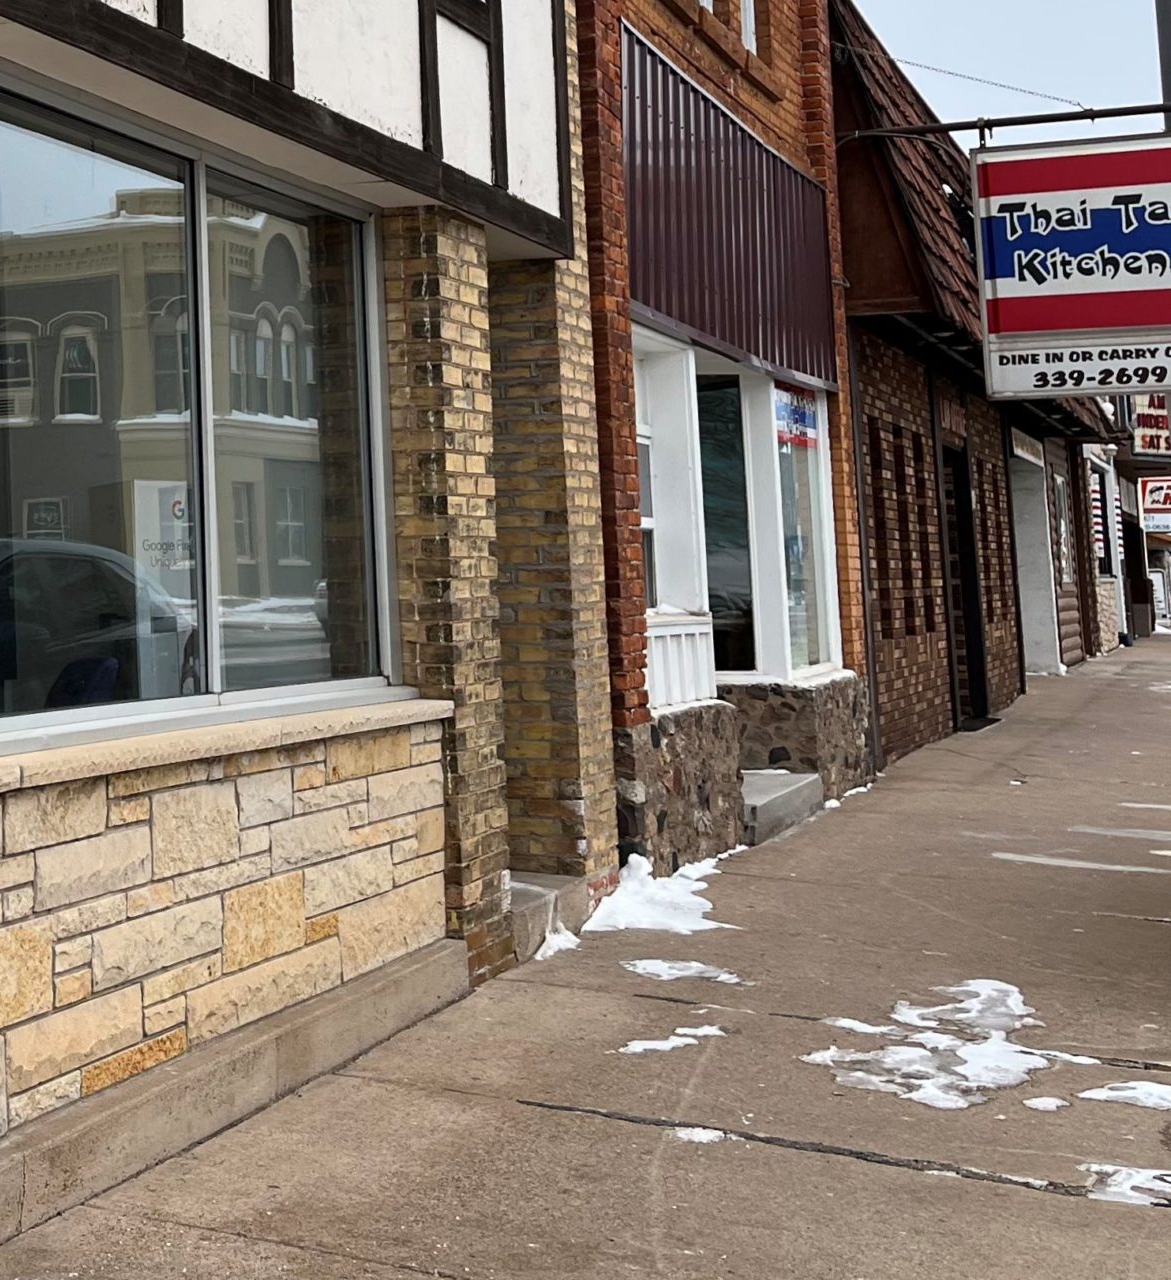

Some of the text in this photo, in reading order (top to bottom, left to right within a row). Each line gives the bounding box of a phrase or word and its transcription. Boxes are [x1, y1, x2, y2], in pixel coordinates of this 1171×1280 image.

[997, 198, 1088, 239] Thai
[1015, 247, 1168, 286] Kitchen
[998, 353, 1040, 366] DINE
[1045, 352, 1064, 364] IN
[1069, 351, 1094, 363] OR
[1098, 347, 1160, 361] CARRY
[1033, 366, 1168, 389] 339-2699
[142, 539, 175, 555] Google
